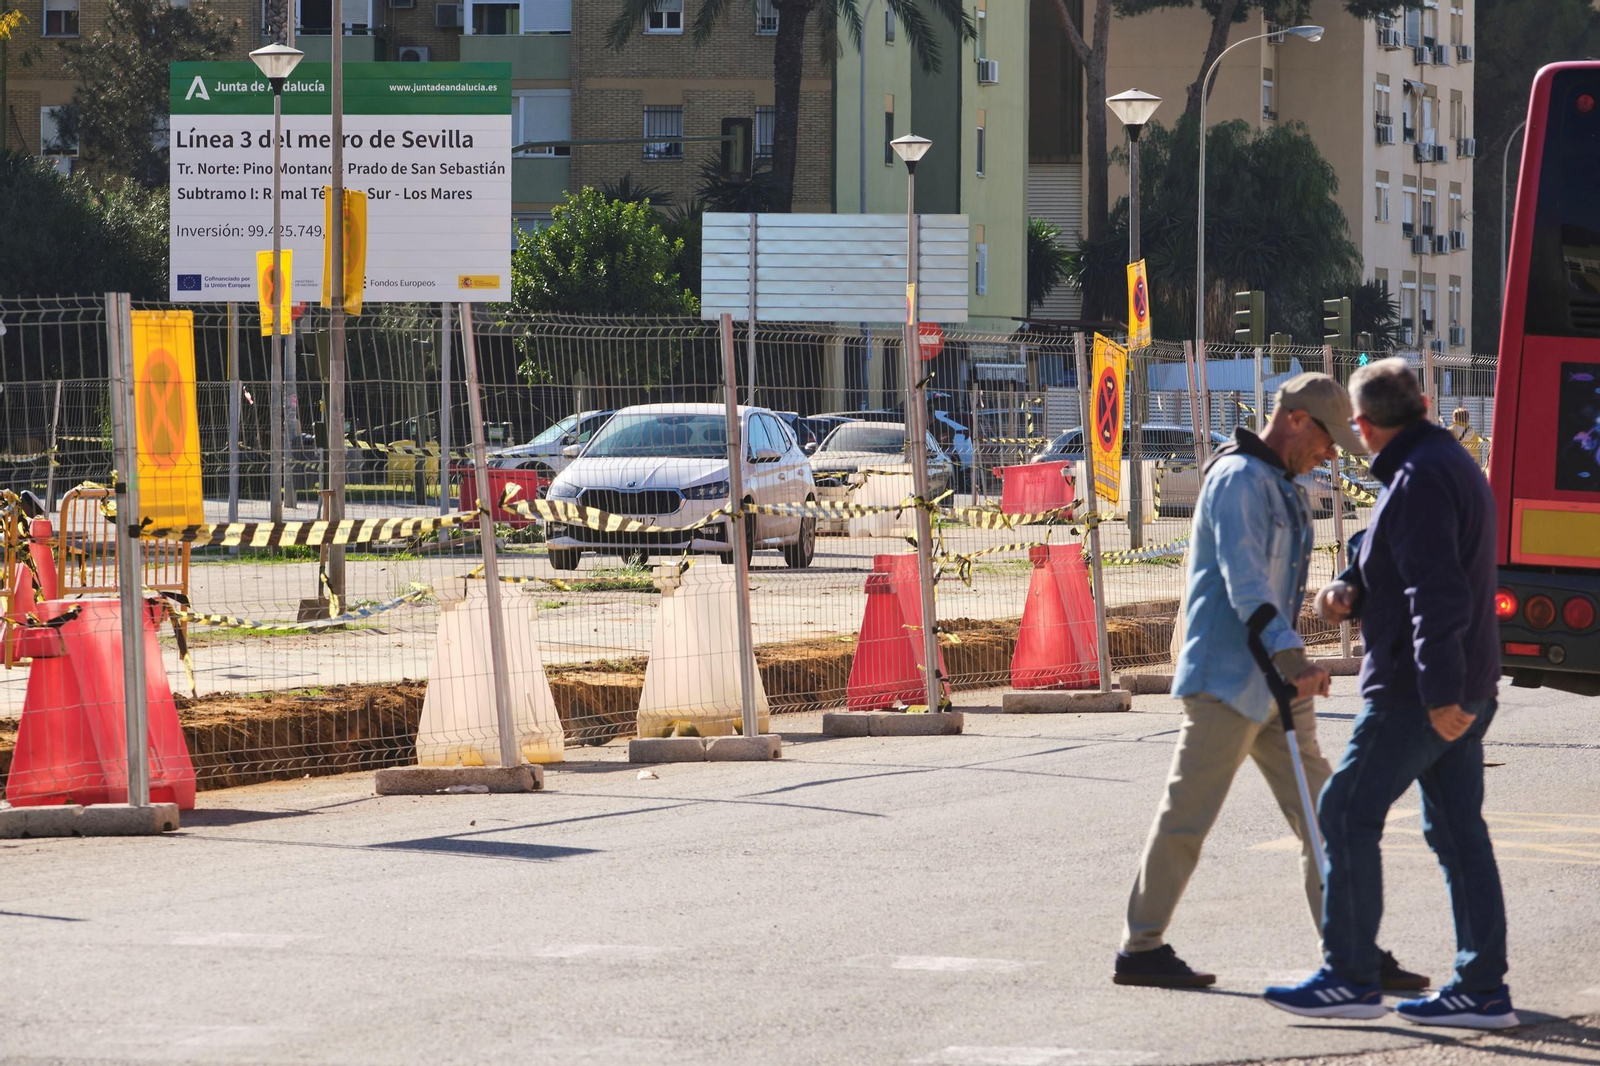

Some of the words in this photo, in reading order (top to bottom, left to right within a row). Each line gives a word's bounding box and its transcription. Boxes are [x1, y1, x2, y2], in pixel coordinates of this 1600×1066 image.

[214, 81, 248, 92] Junta
[250, 81, 265, 92] de
[267, 80, 325, 92] Adalucía
[389, 84, 498, 93] www.juntadeandalucia.es
[176, 127, 234, 148] Línea
[240, 131, 252, 148] 3
[298, 134, 363, 148] mero
[369, 130, 396, 148] de
[402, 130, 474, 148] Sevilla
[177, 163, 194, 175] Tr.
[198, 163, 239, 175] Norte:
[244, 162, 273, 175] Pino
[348, 162, 388, 174] Prado
[391, 162, 408, 174] de
[411, 163, 436, 174] San
[440, 161, 505, 174] Sebastián
[177, 188, 246, 200] Subtramo
[263, 187, 307, 200] Rmal
[368, 188, 391, 200] Sur
[404, 188, 427, 200] Los
[431, 188, 472, 200] Mares
[176, 224, 244, 237] Inversión:
[400, 280, 436, 288] Europeos
